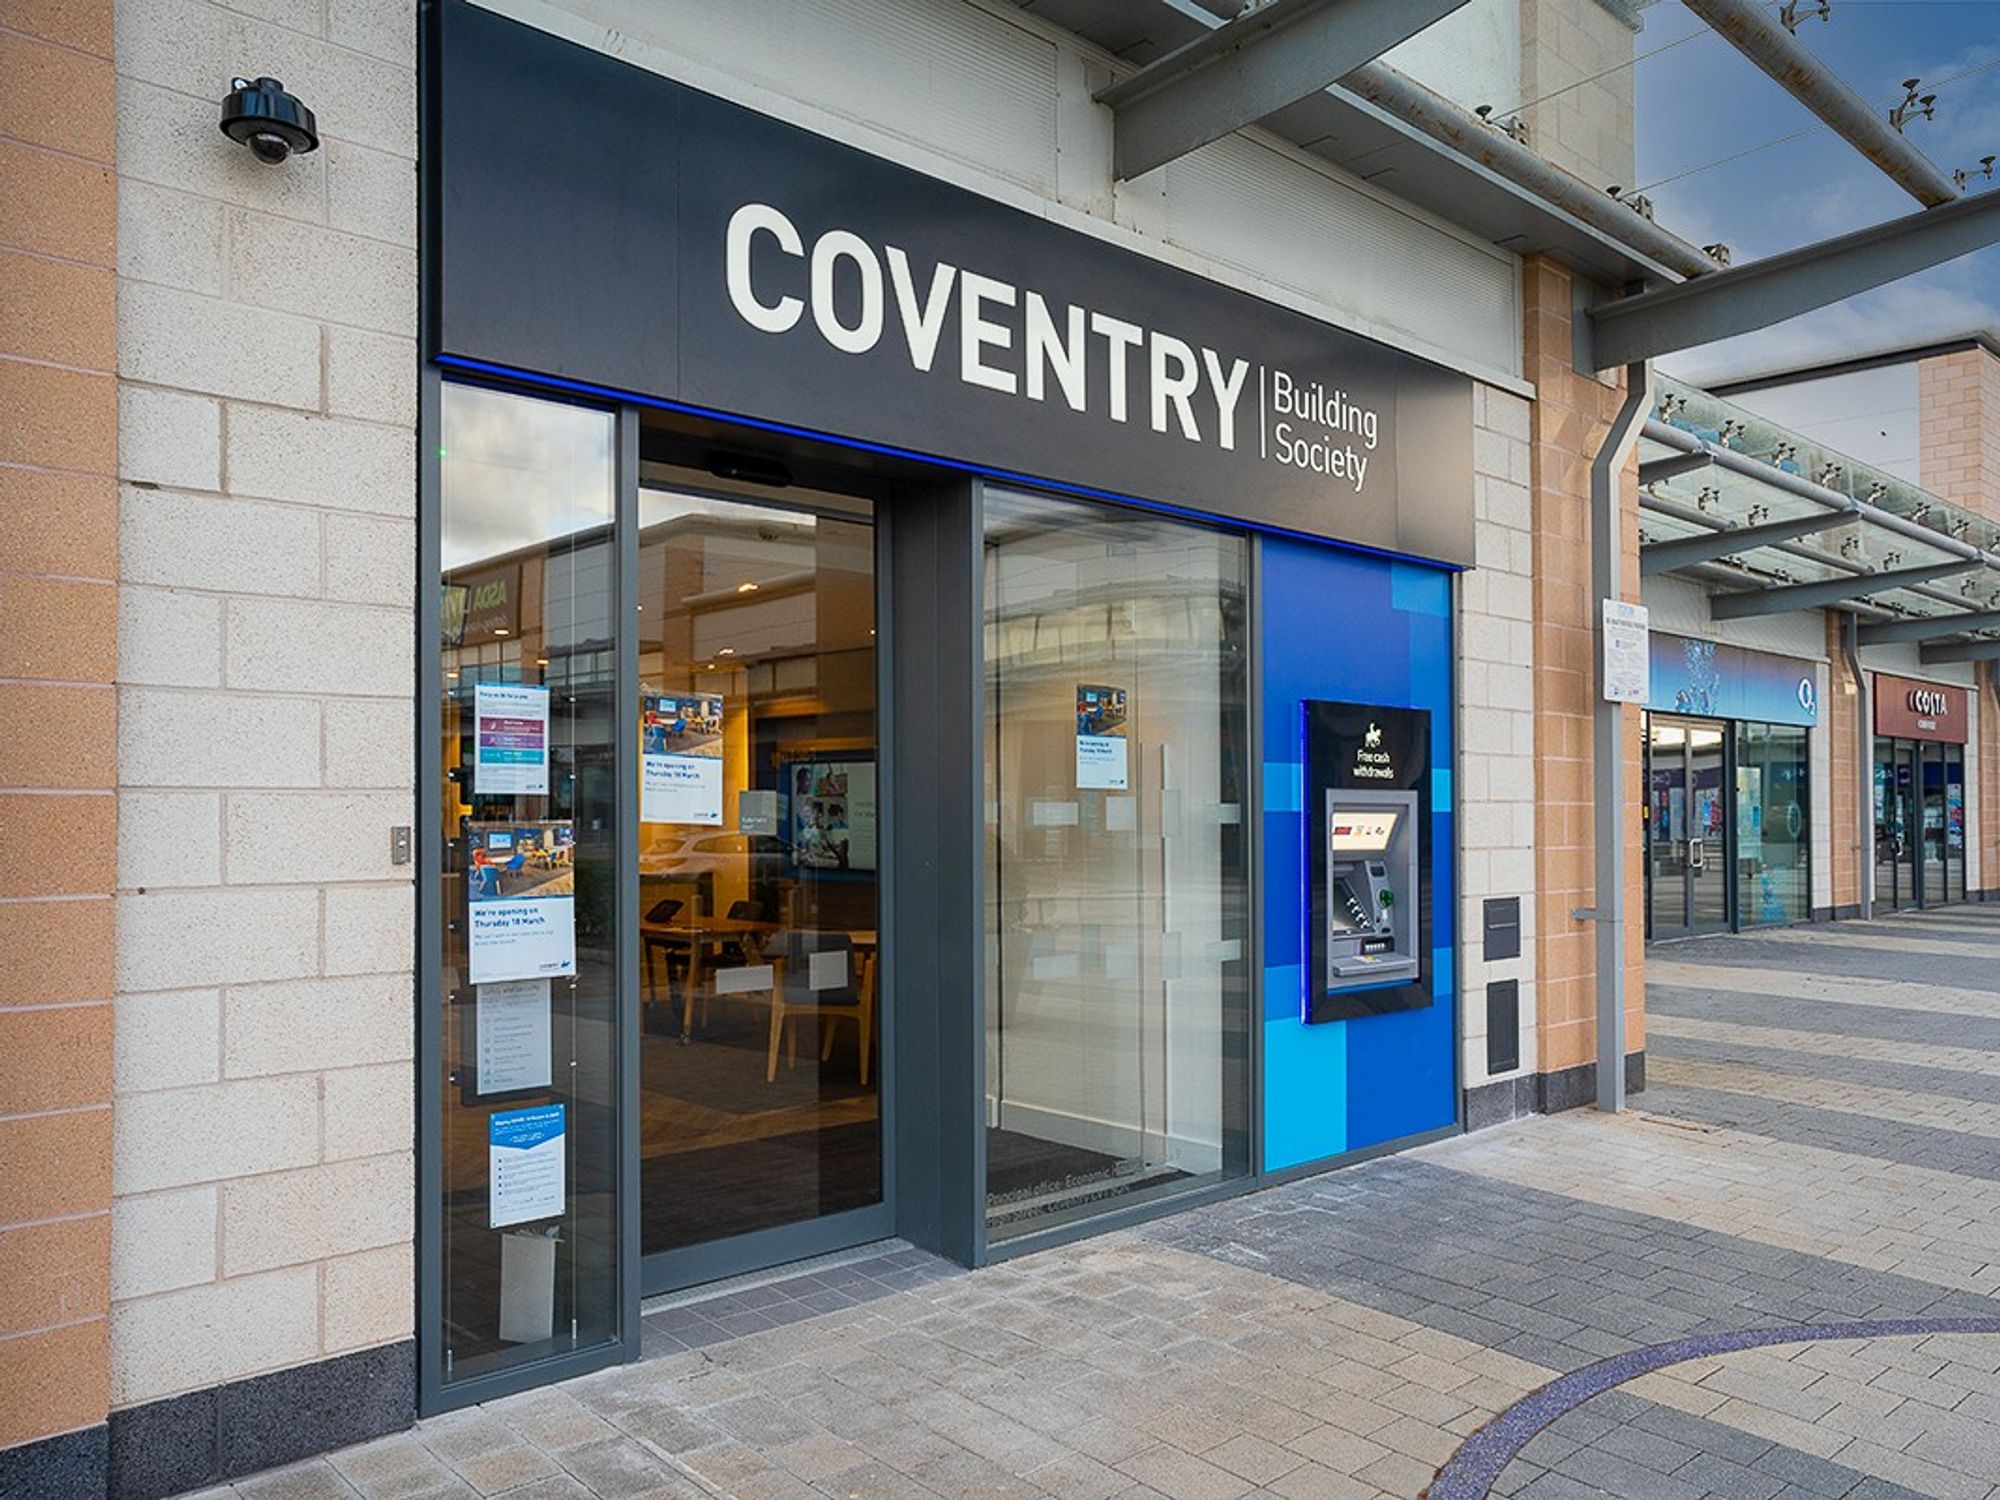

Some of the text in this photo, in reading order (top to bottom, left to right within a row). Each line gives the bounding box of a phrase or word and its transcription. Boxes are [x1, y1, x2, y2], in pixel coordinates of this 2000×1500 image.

[726, 203, 1249, 451] COVENTRY
[1274, 370, 1377, 449] Building
[1275, 422, 1367, 492] Society
[1915, 689, 1947, 716] COSTA
[1357, 748, 1390, 763] Free cash
[1353, 764, 1394, 779] withdrawals
[475, 919, 509, 928] Thursday
[522, 917, 545, 925] March
[498, 907, 527, 918] opening
